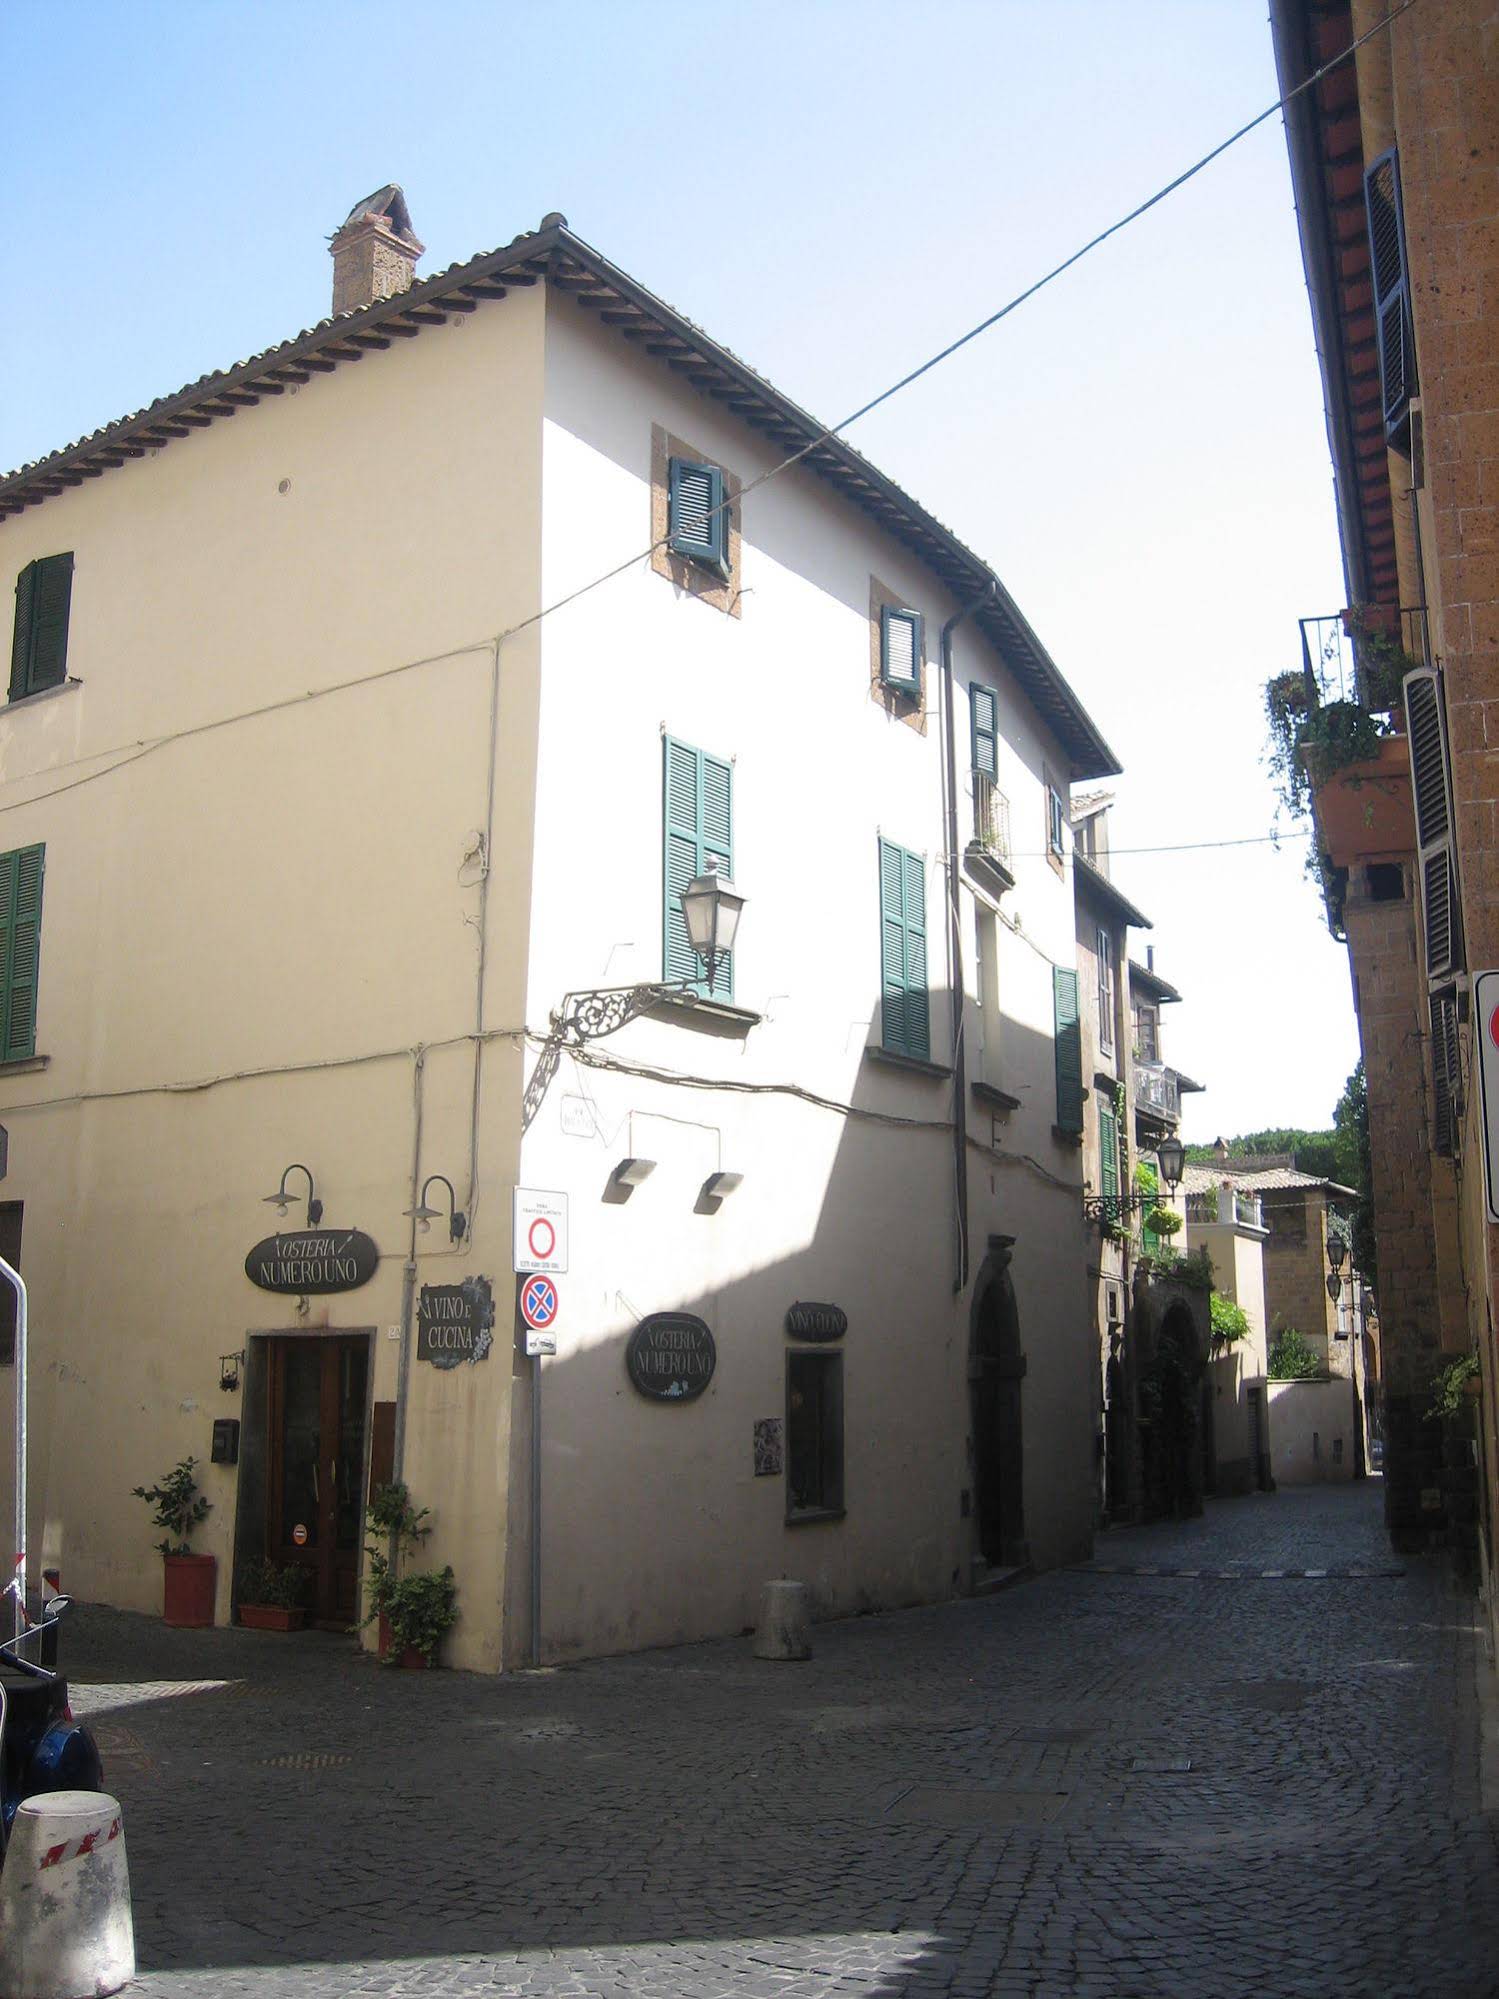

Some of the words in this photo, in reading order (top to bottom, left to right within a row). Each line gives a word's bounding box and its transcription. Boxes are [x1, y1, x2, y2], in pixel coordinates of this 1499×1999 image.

[282, 1239, 335, 1258] OSTERIA
[260, 1260, 322, 1285] NUMERO
[324, 1258, 357, 1282] UNO
[434, 1297, 464, 1319] VINO
[428, 1326, 473, 1348] CUCINA
[654, 1330, 696, 1349] OSTERIA
[638, 1351, 686, 1374] NUMERO
[687, 1351, 711, 1375] UNO
